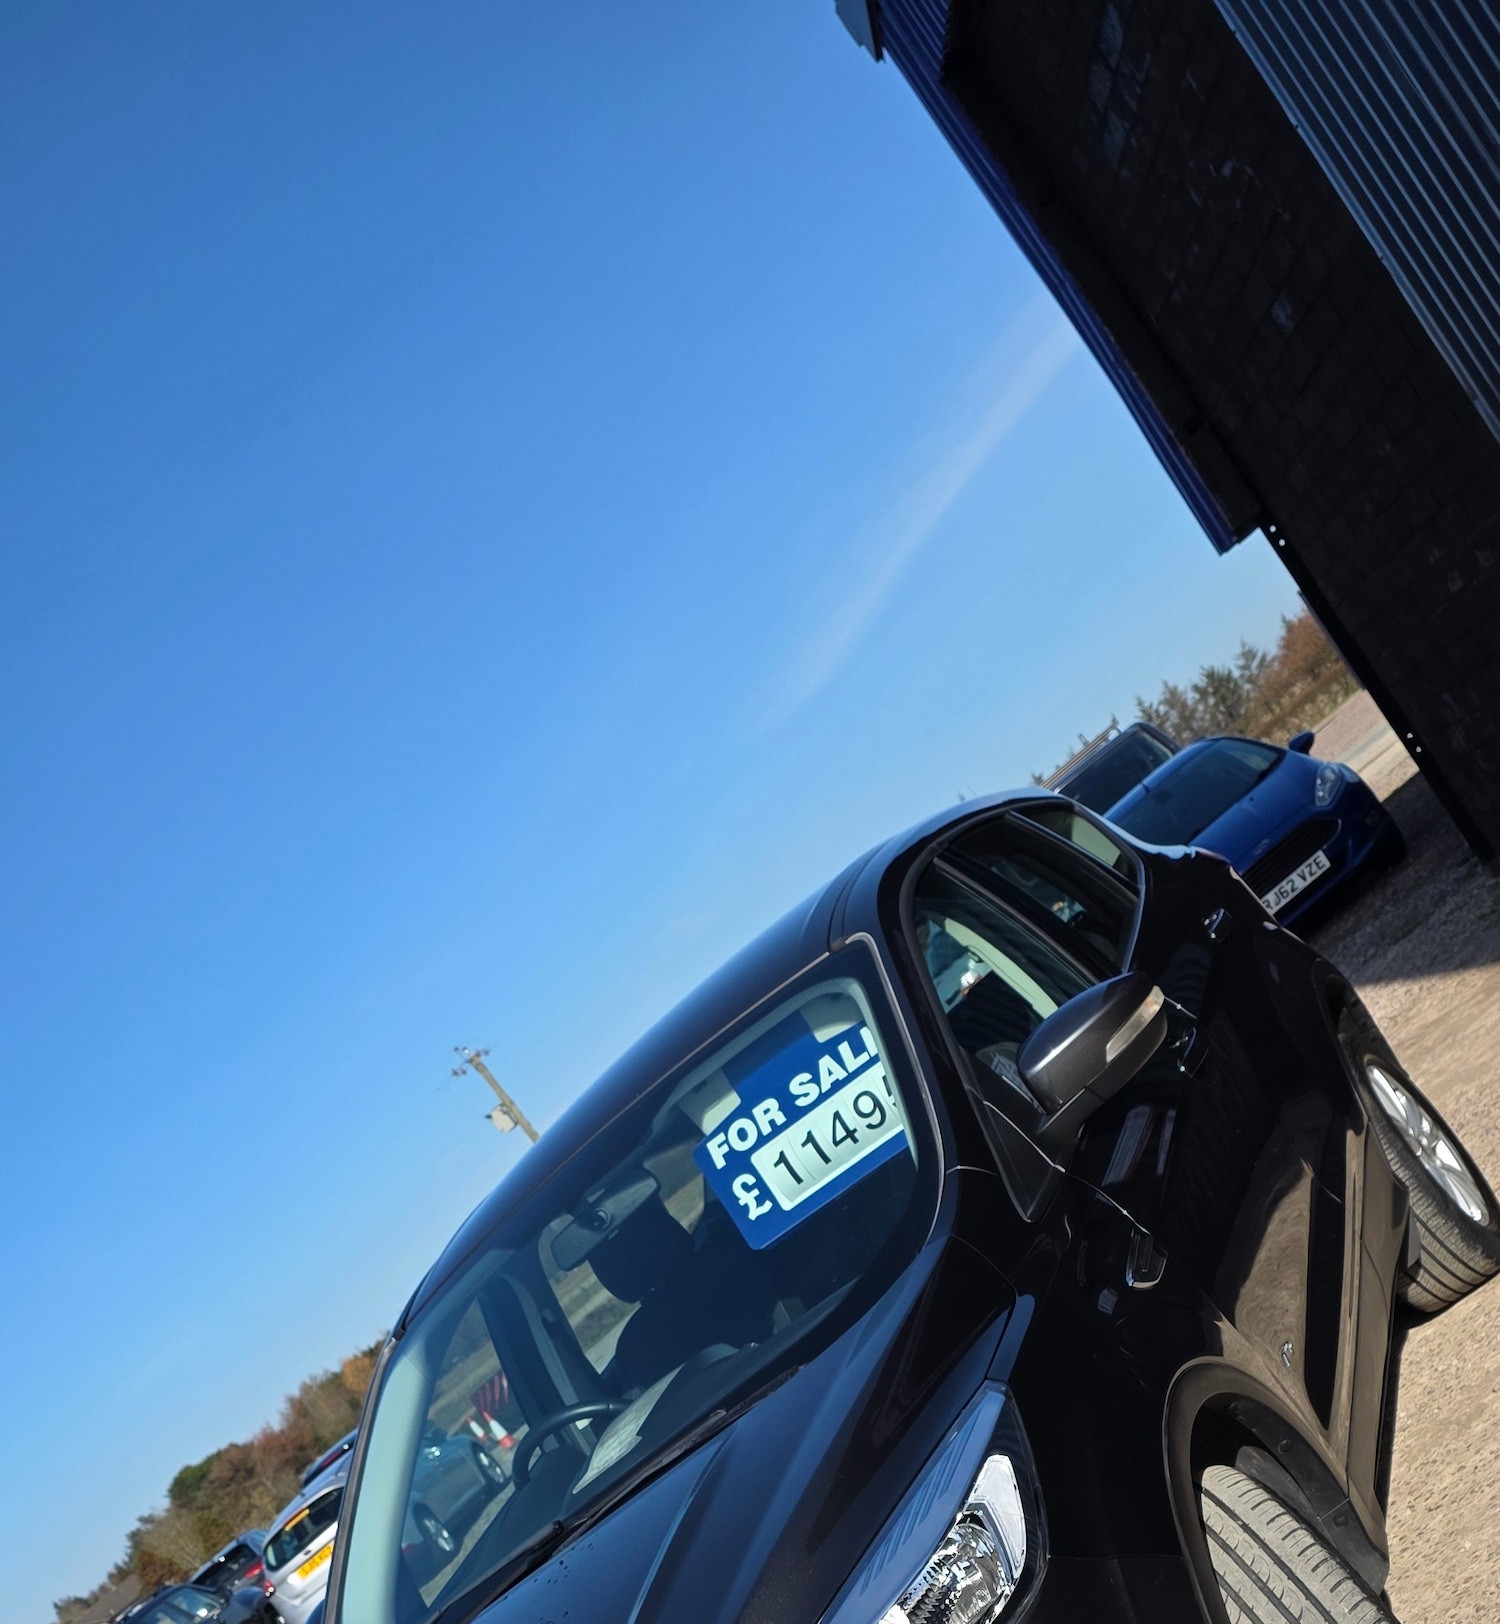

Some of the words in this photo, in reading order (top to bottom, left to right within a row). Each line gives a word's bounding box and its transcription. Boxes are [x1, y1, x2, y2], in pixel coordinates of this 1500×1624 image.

[1297, 855, 1326, 882] VZE
[706, 1098, 787, 1169] FOR
[732, 1173, 773, 1221] £
[773, 1073, 898, 1185] 1149
